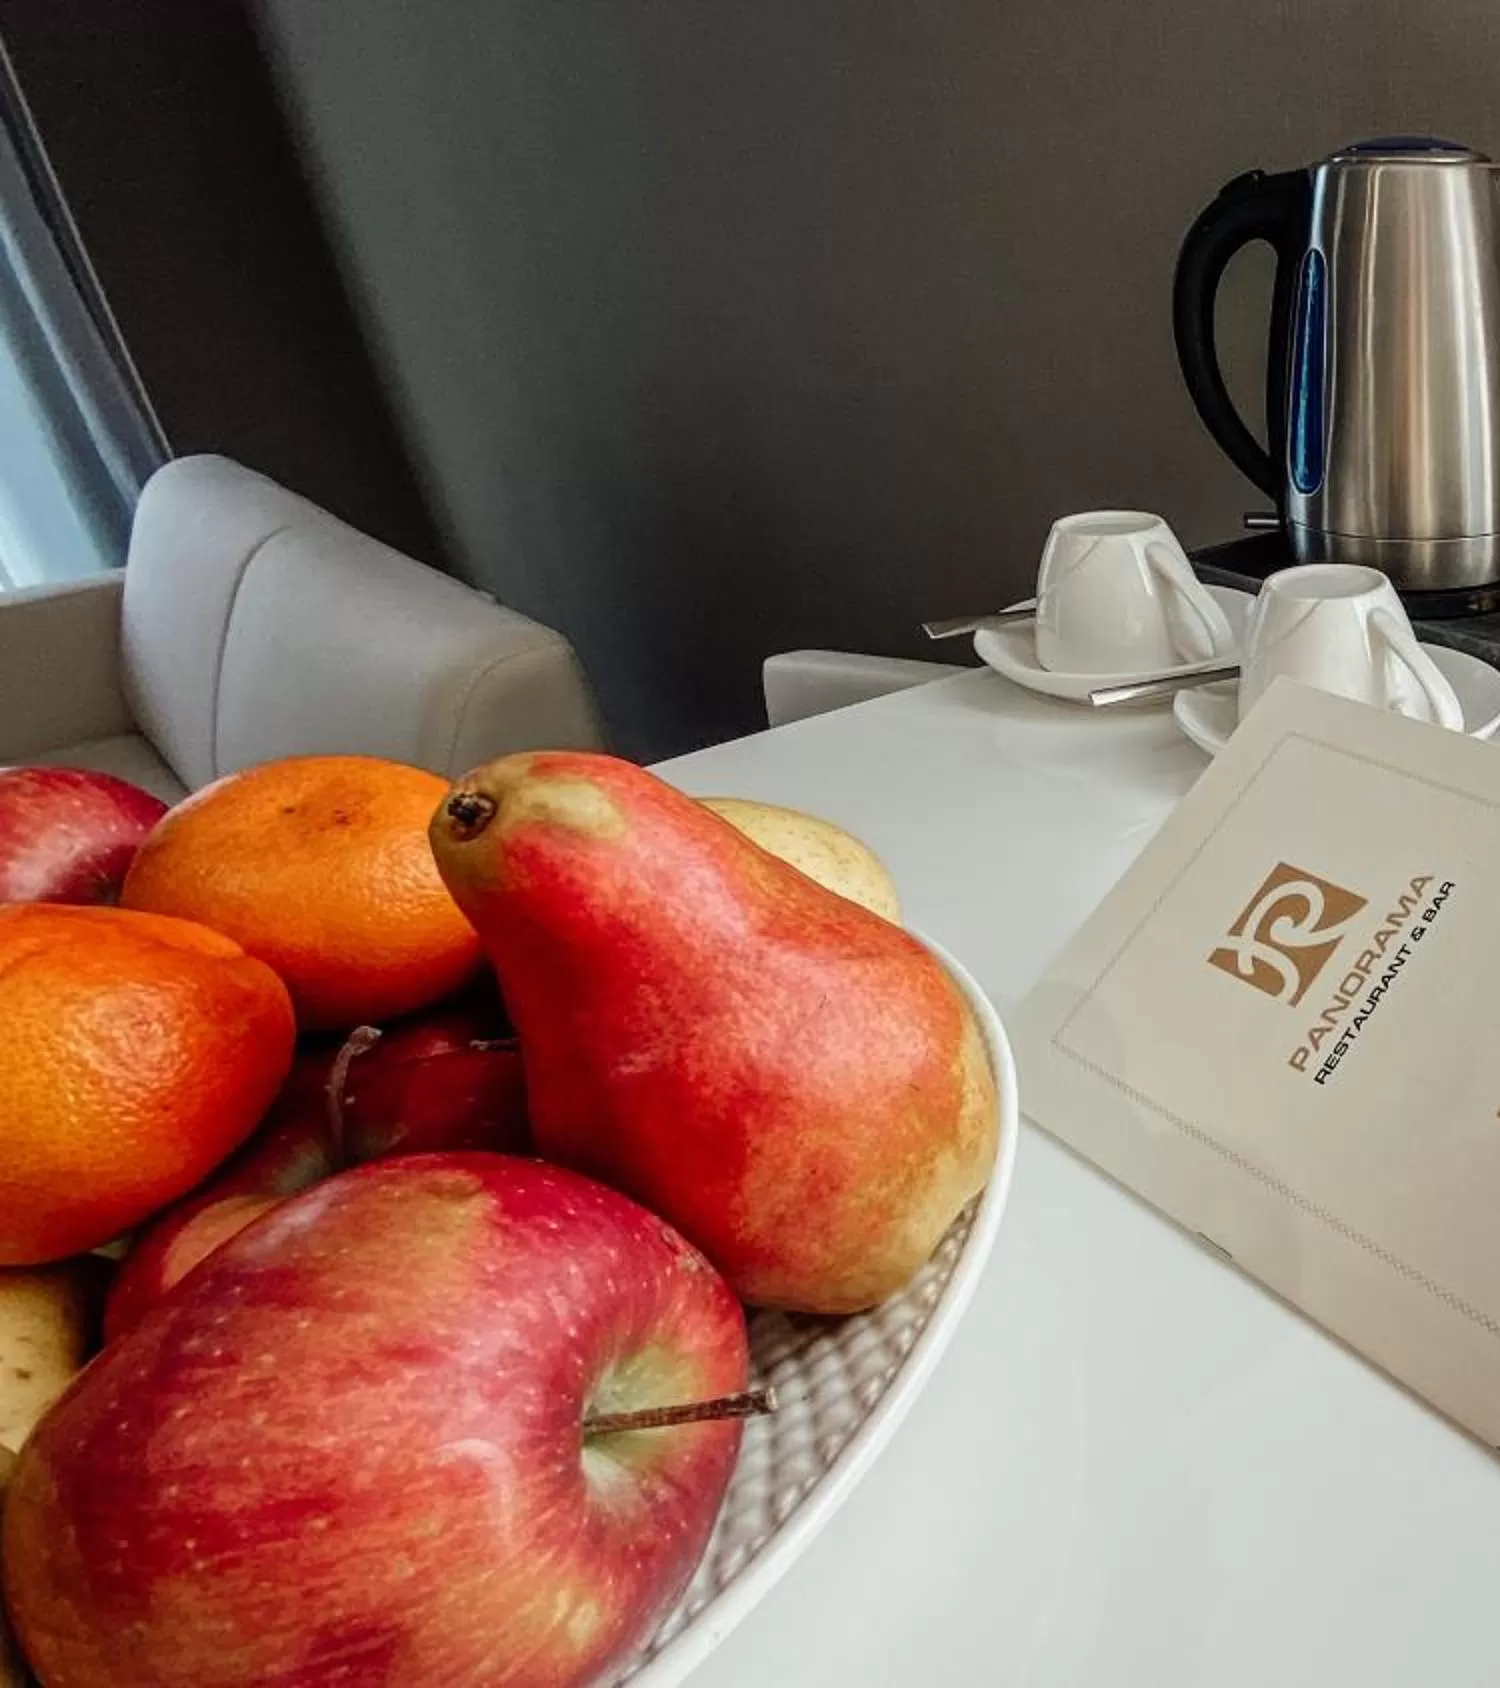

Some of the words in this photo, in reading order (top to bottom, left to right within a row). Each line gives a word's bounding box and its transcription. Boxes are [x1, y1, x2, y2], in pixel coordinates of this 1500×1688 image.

[1288, 873, 1435, 1073] PANORAMA
[1313, 943, 1411, 1086] RESTAURANT
[1410, 925, 1427, 942] &
[1421, 880, 1456, 923] BAR
